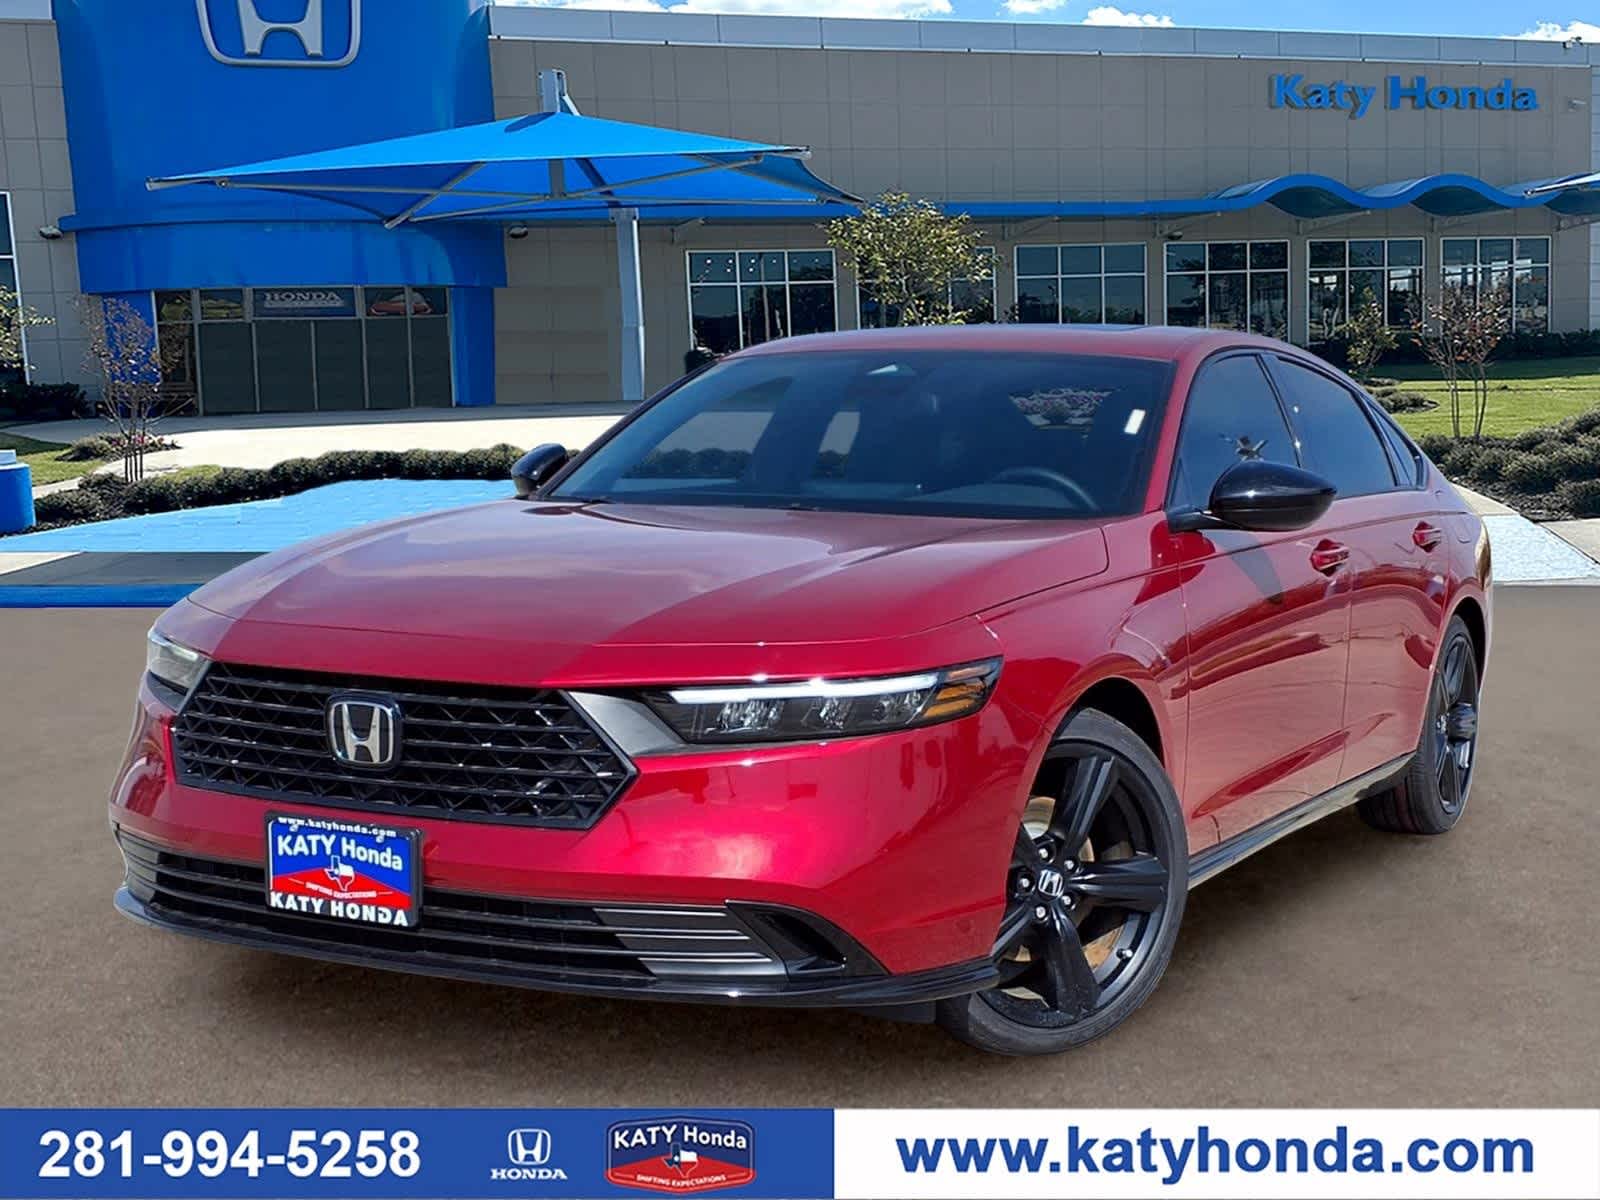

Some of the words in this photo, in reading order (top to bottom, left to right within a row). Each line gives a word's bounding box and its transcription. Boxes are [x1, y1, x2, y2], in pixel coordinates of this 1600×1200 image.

[1270, 73, 1377, 118] Katy
[1385, 75, 1540, 111] Honda
[264, 291, 342, 302] HONDA
[278, 816, 397, 838] www.katyhonda.com
[277, 834, 336, 857] KATY
[341, 837, 404, 871] Honda
[270, 891, 325, 915] KATY
[330, 900, 409, 927] HONDA
